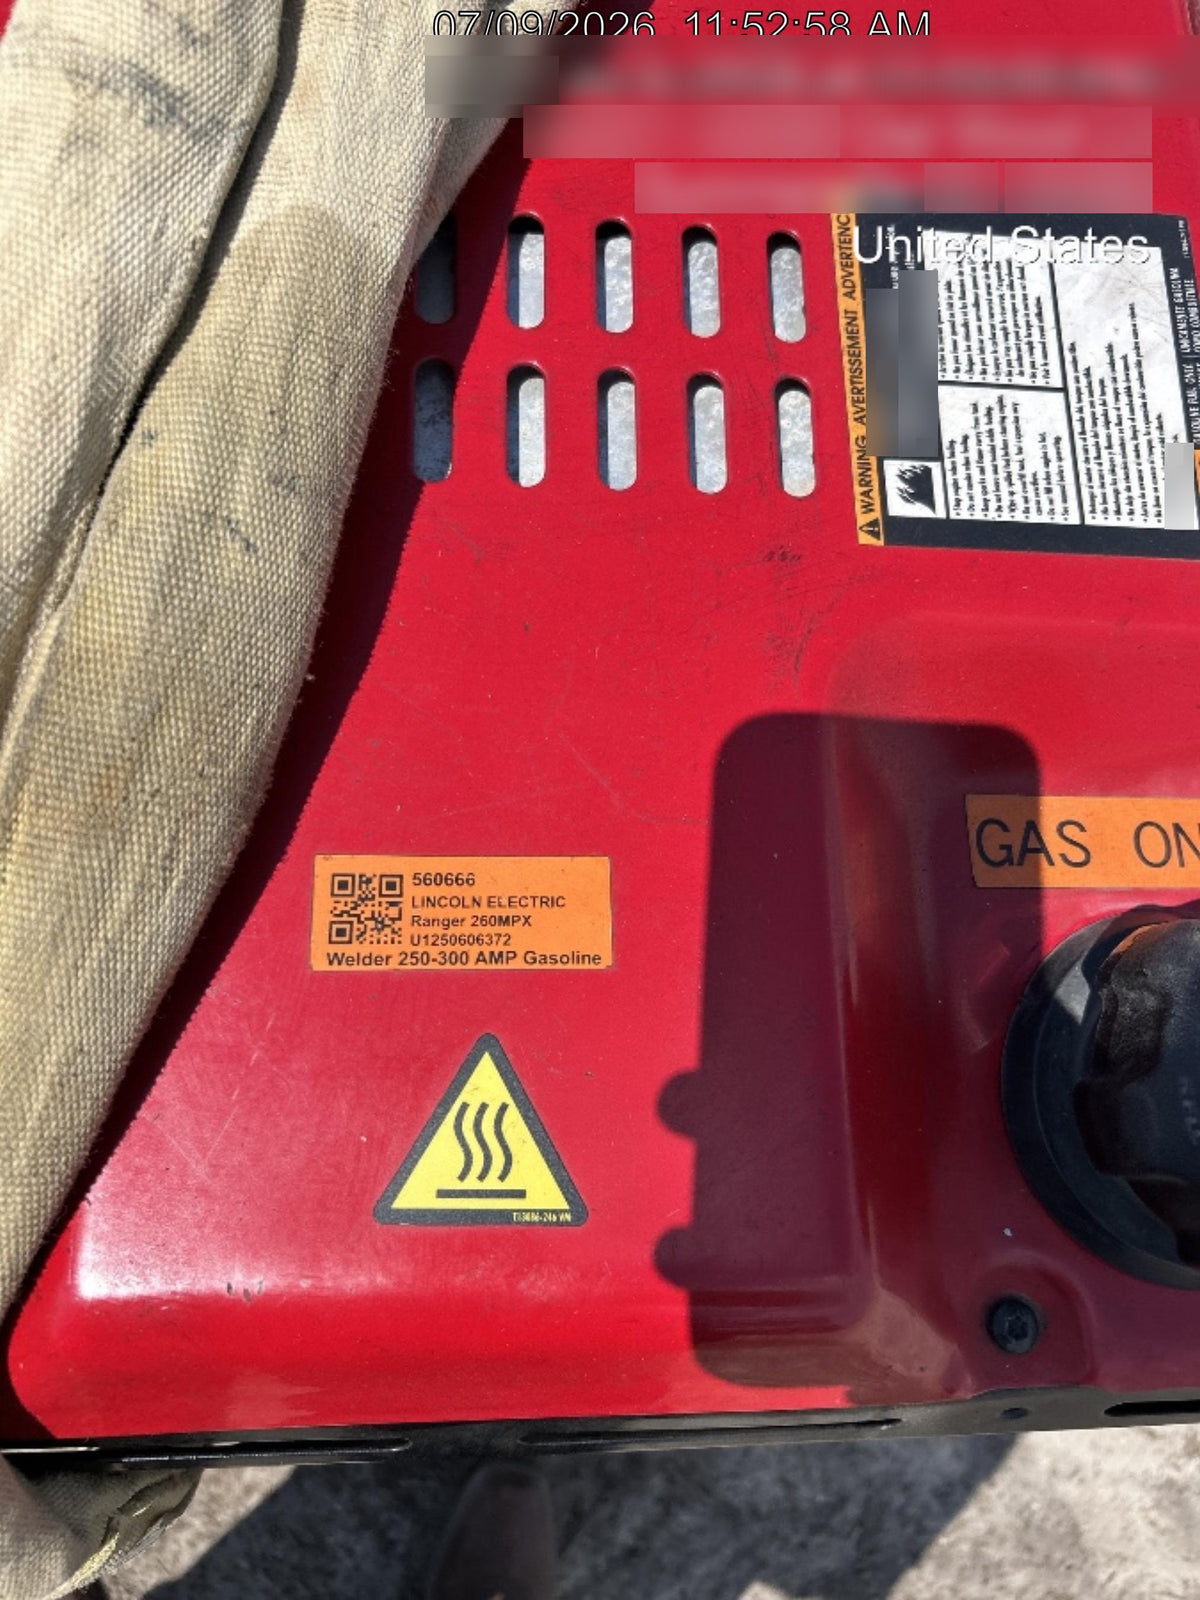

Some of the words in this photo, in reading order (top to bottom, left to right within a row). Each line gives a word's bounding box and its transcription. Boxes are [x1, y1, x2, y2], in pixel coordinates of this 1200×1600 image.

[849, 309, 867, 426] AVERTISSEMENT
[858, 436, 875, 514] WARNING
[976, 818, 1092, 869] GAS
[412, 873, 475, 887] 560666
[411, 896, 481, 909] LINCOLN
[487, 896, 566, 909] ELECTRIC
[411, 914, 465, 930] Ranger
[471, 914, 532, 927] 260MPX
[410, 934, 512, 947] U1250606372
[327, 951, 393, 966] Welder
[399, 951, 469, 966] 250-300
[475, 951, 516, 966] AMP
[523, 951, 602, 966] Gasoline
